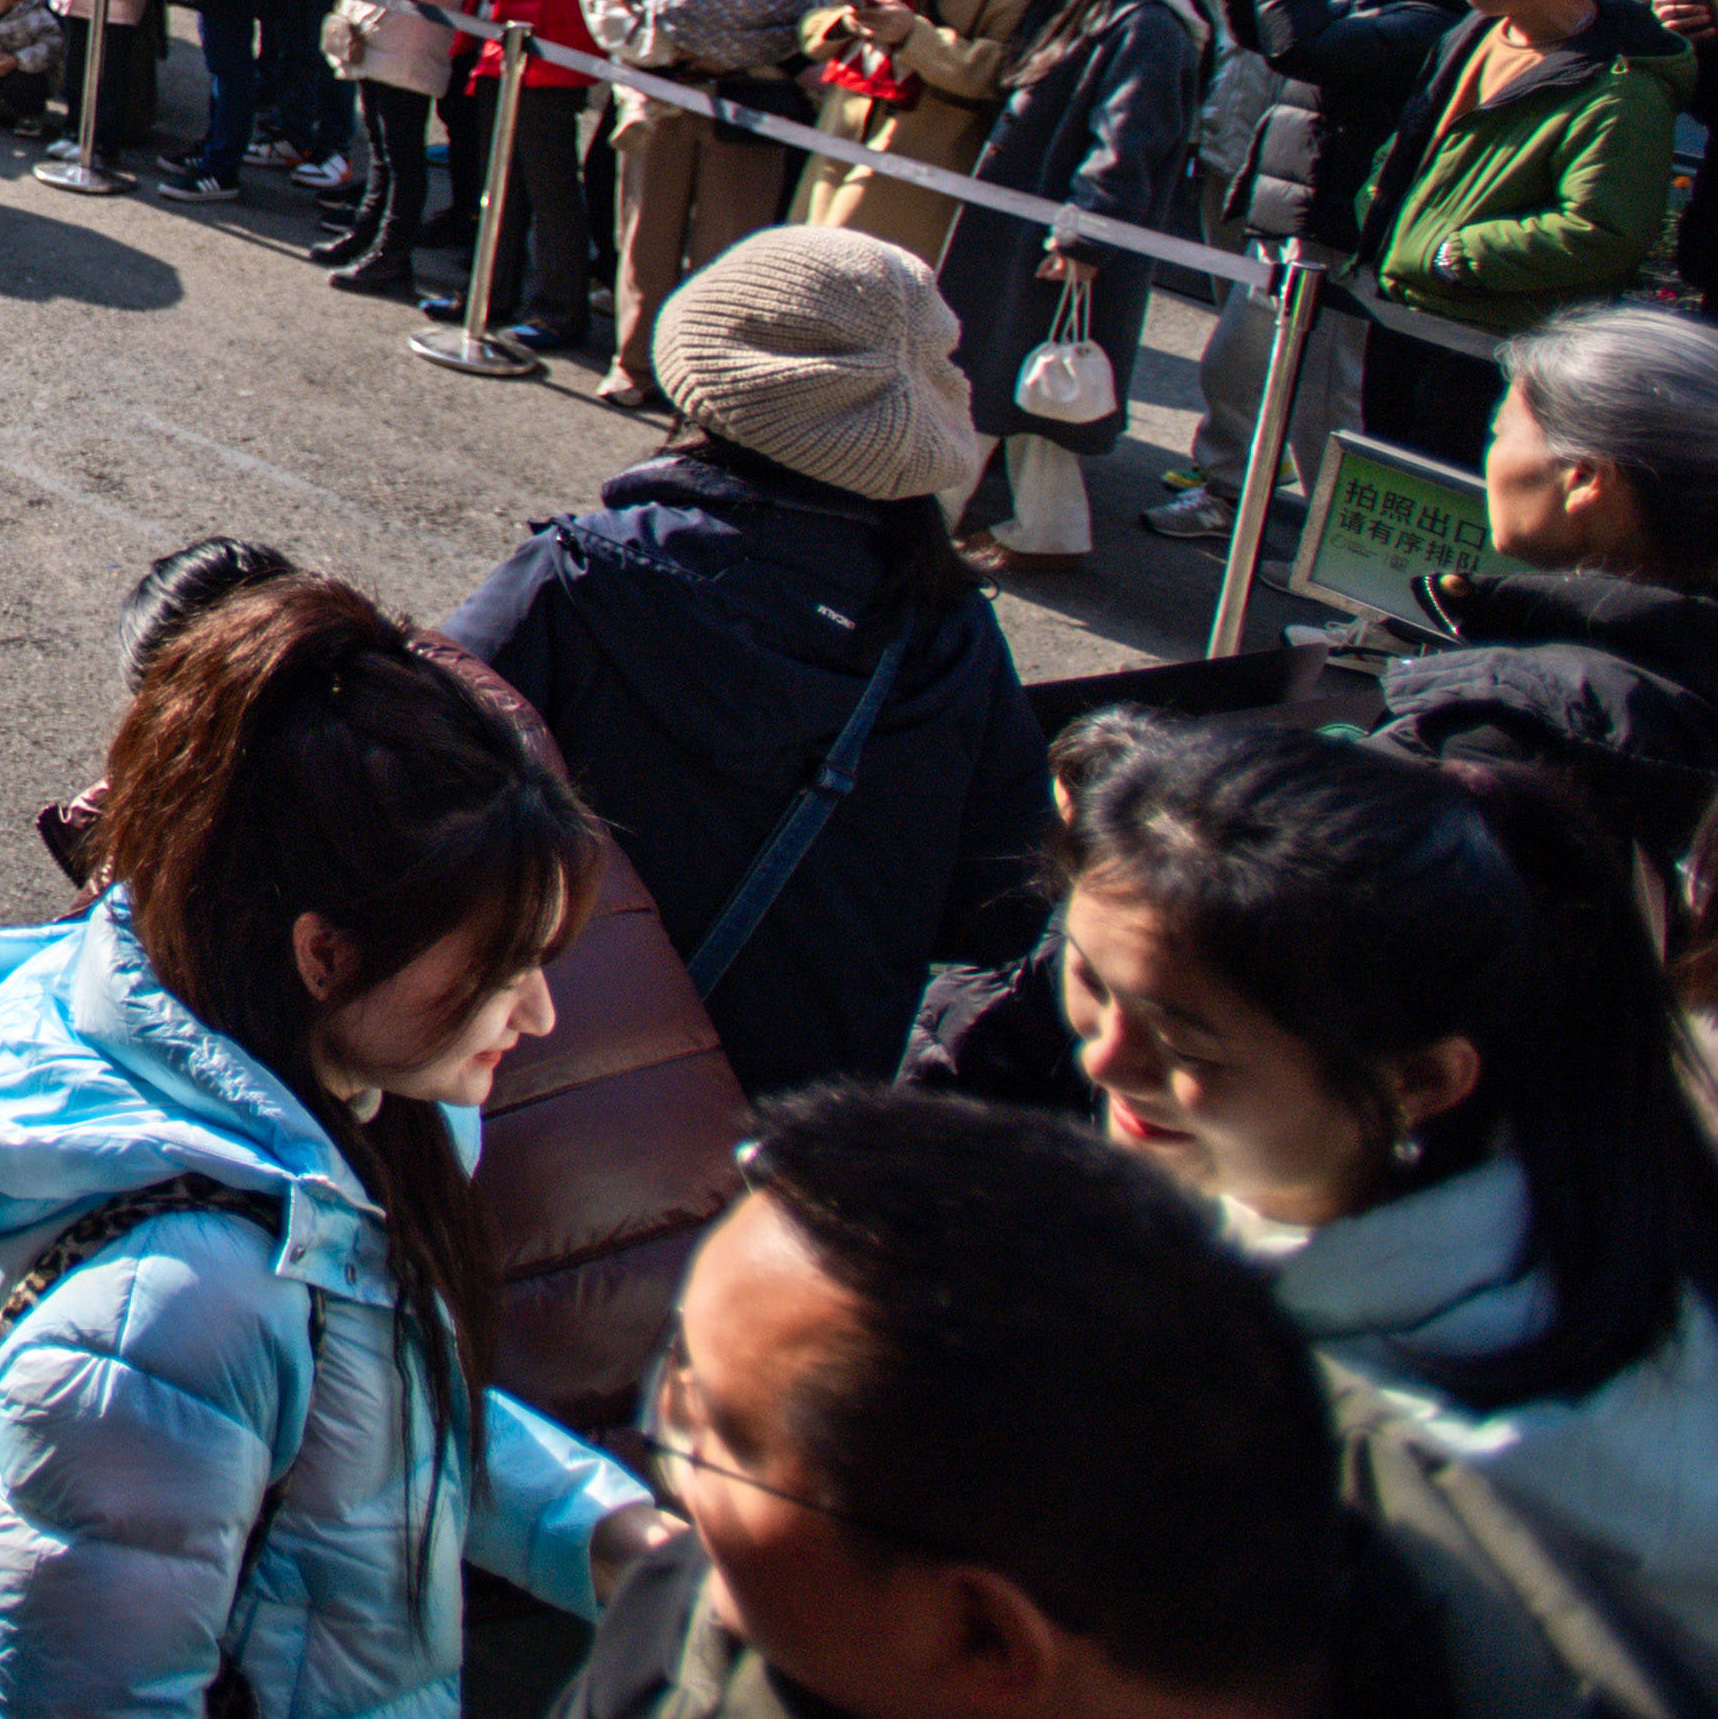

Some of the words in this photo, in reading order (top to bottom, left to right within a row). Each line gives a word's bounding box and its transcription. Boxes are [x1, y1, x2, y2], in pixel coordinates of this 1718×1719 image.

[1338, 507, 1480, 572] 请有序排队
[1345, 477, 1488, 552] 拍照出口
